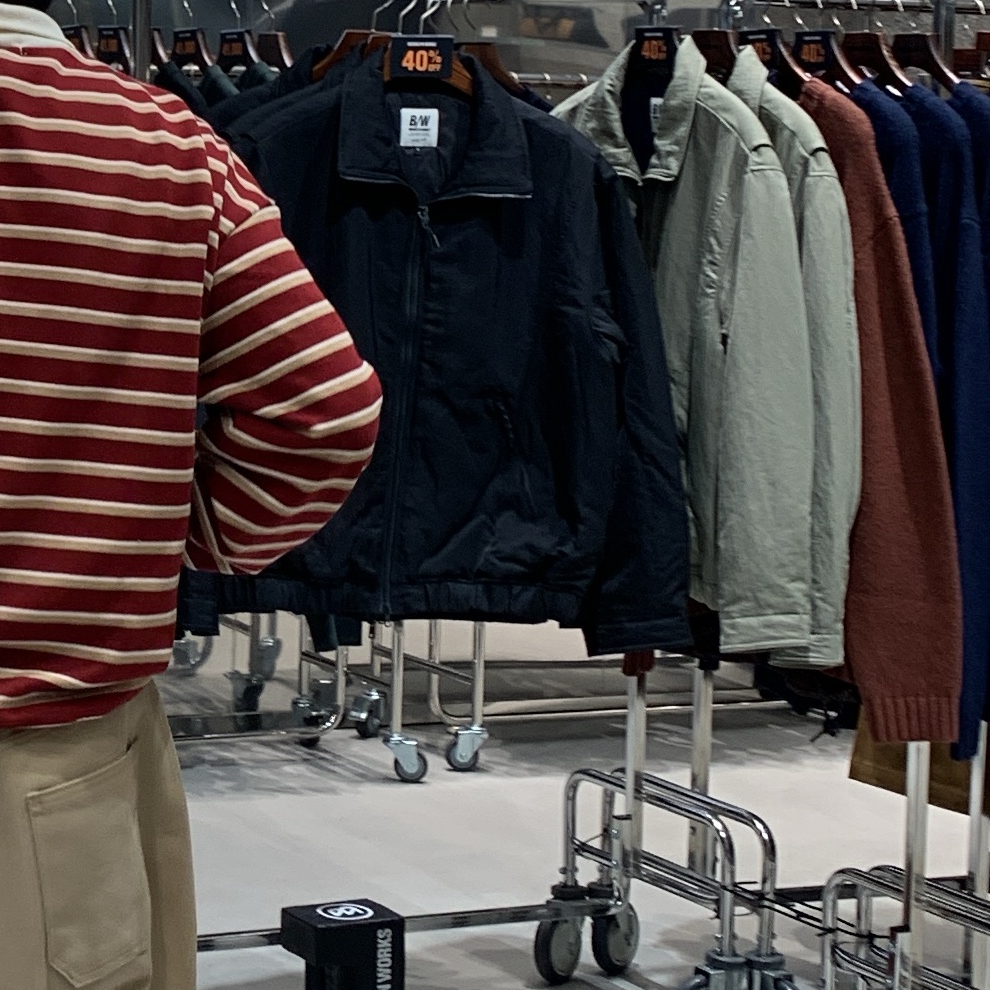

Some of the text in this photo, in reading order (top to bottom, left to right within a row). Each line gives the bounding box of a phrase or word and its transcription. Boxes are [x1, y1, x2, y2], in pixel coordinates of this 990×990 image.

[401, 49, 442, 71] 40%
[410, 114, 431, 127] B/W
[376, 928, 393, 983] WORKS
